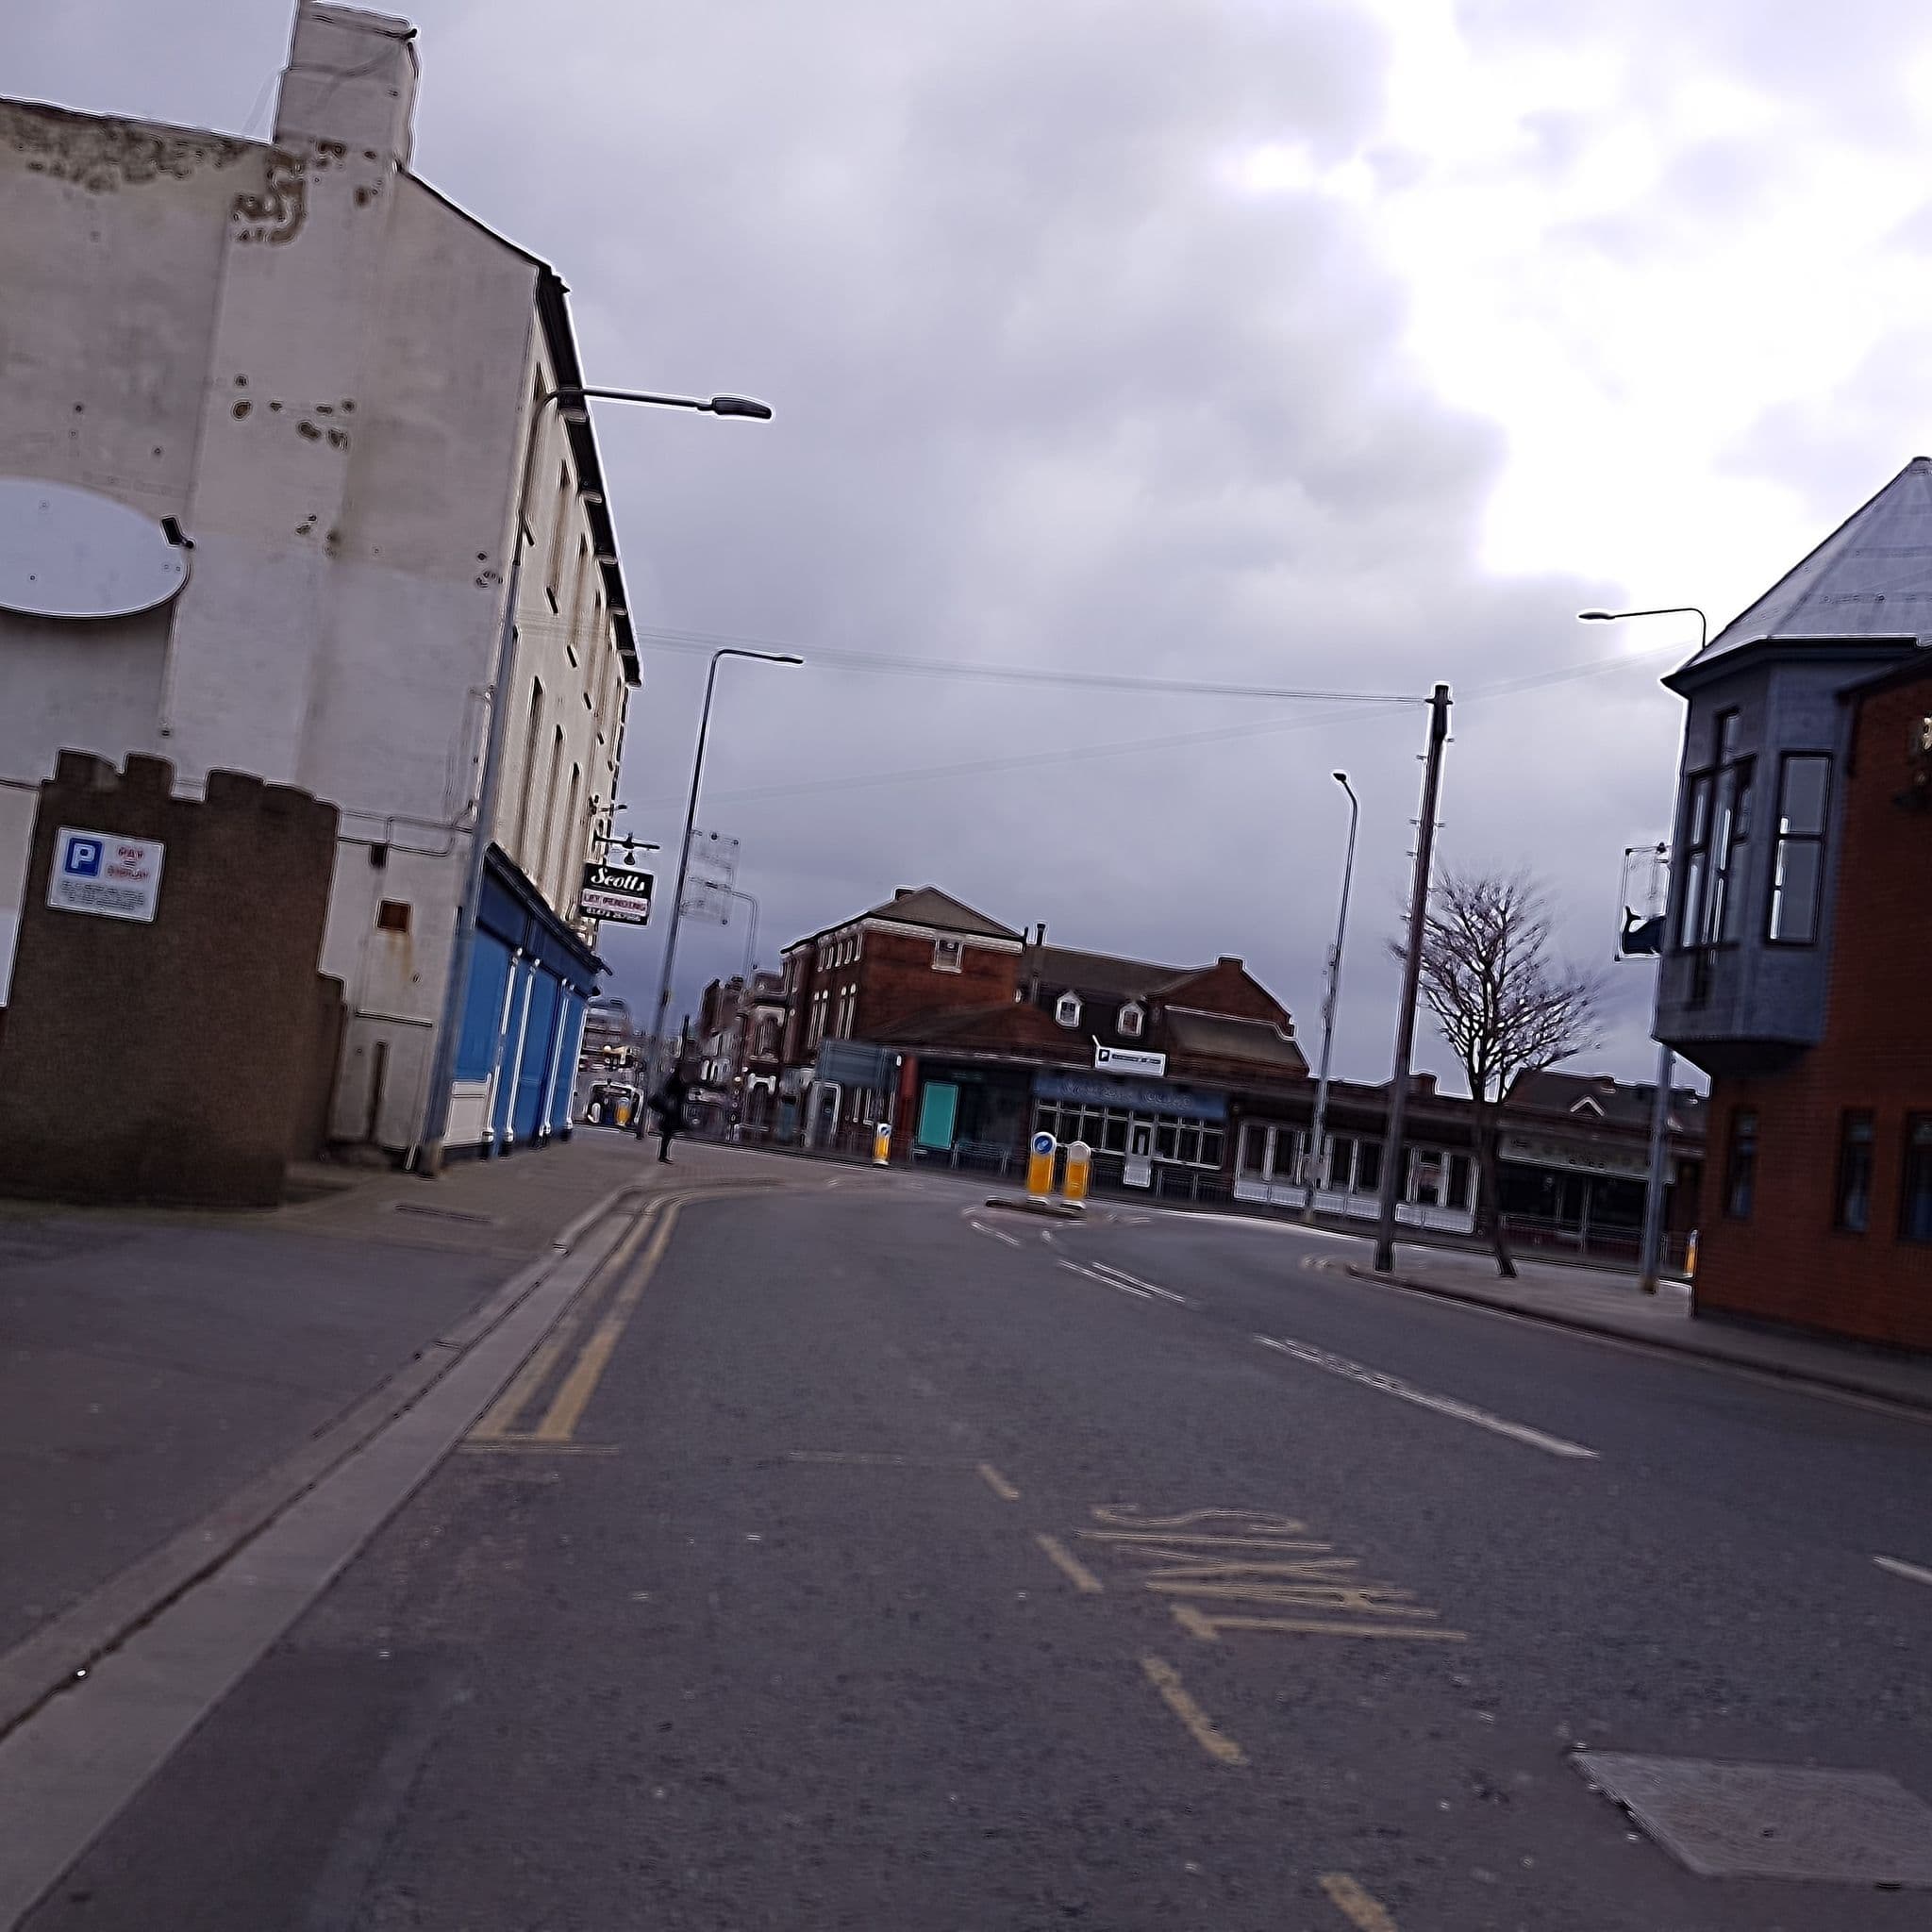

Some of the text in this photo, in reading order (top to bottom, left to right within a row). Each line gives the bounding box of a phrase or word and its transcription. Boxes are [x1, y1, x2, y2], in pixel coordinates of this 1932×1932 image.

[71, 842, 95, 869] P
[591, 867, 645, 891] Scotts
[1072, 1503, 1469, 1641] TAXIS
